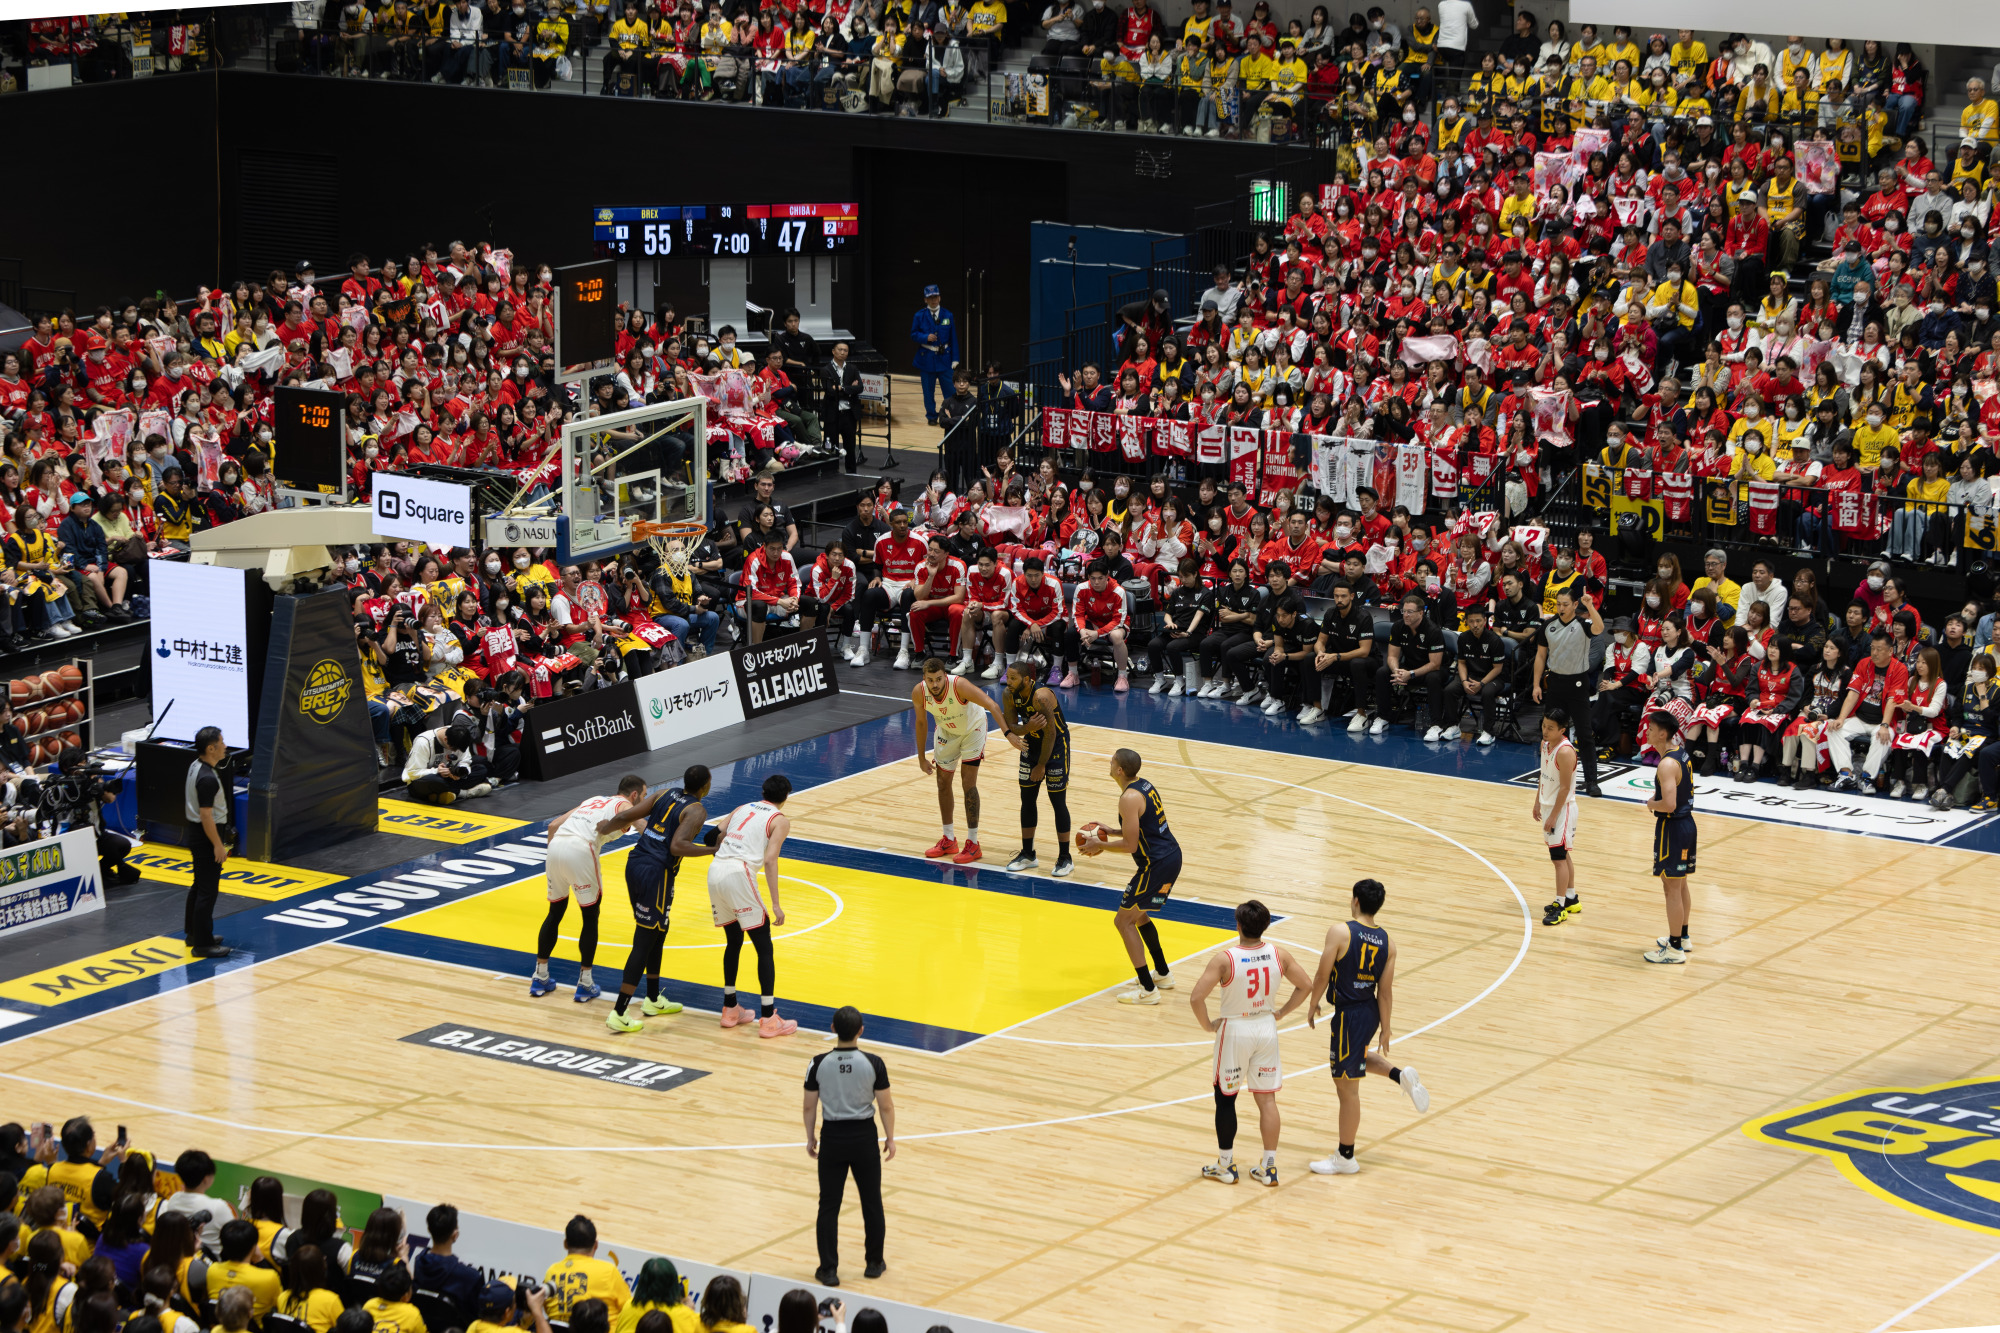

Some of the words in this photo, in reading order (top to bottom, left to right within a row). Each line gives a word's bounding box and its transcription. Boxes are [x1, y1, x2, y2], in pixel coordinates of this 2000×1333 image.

[641, 209, 658, 219] BREX
[721, 206, 732, 219] 3Q
[789, 206, 810, 216] CHIBA
[811, 206, 817, 216] J
[618, 242, 626, 253] 3
[644, 224, 671, 255] 55
[712, 233, 750, 255] 7:00
[778, 221, 807, 252] 47
[826, 237, 835, 249] 3
[576, 278, 603, 302] 7:00
[299, 405, 330, 428] 7:00
[1233, 430, 1256, 444] 5
[1265, 453, 1287, 465] FUMIO
[1402, 452, 1419, 473] 33
[405, 499, 465, 525] Square
[523, 527, 550, 540] NASU
[173, 637, 244, 666] 中村土建
[756, 637, 818, 669] りそなグループ
[301, 682, 350, 712] BREX
[664, 679, 730, 714] りそなグループ
[748, 662, 828, 710] B.LEAGUE
[565, 710, 636, 747] SoftBank
[660, 802, 676, 824] 1
[736, 811, 756, 832] 1
[1359, 942, 1379, 972] 17
[30, 947, 185, 998] MANI
[1246, 966, 1271, 999] 31
[428, 1029, 626, 1076] B.LEAGUE
[839, 1063, 853, 1074] 93
